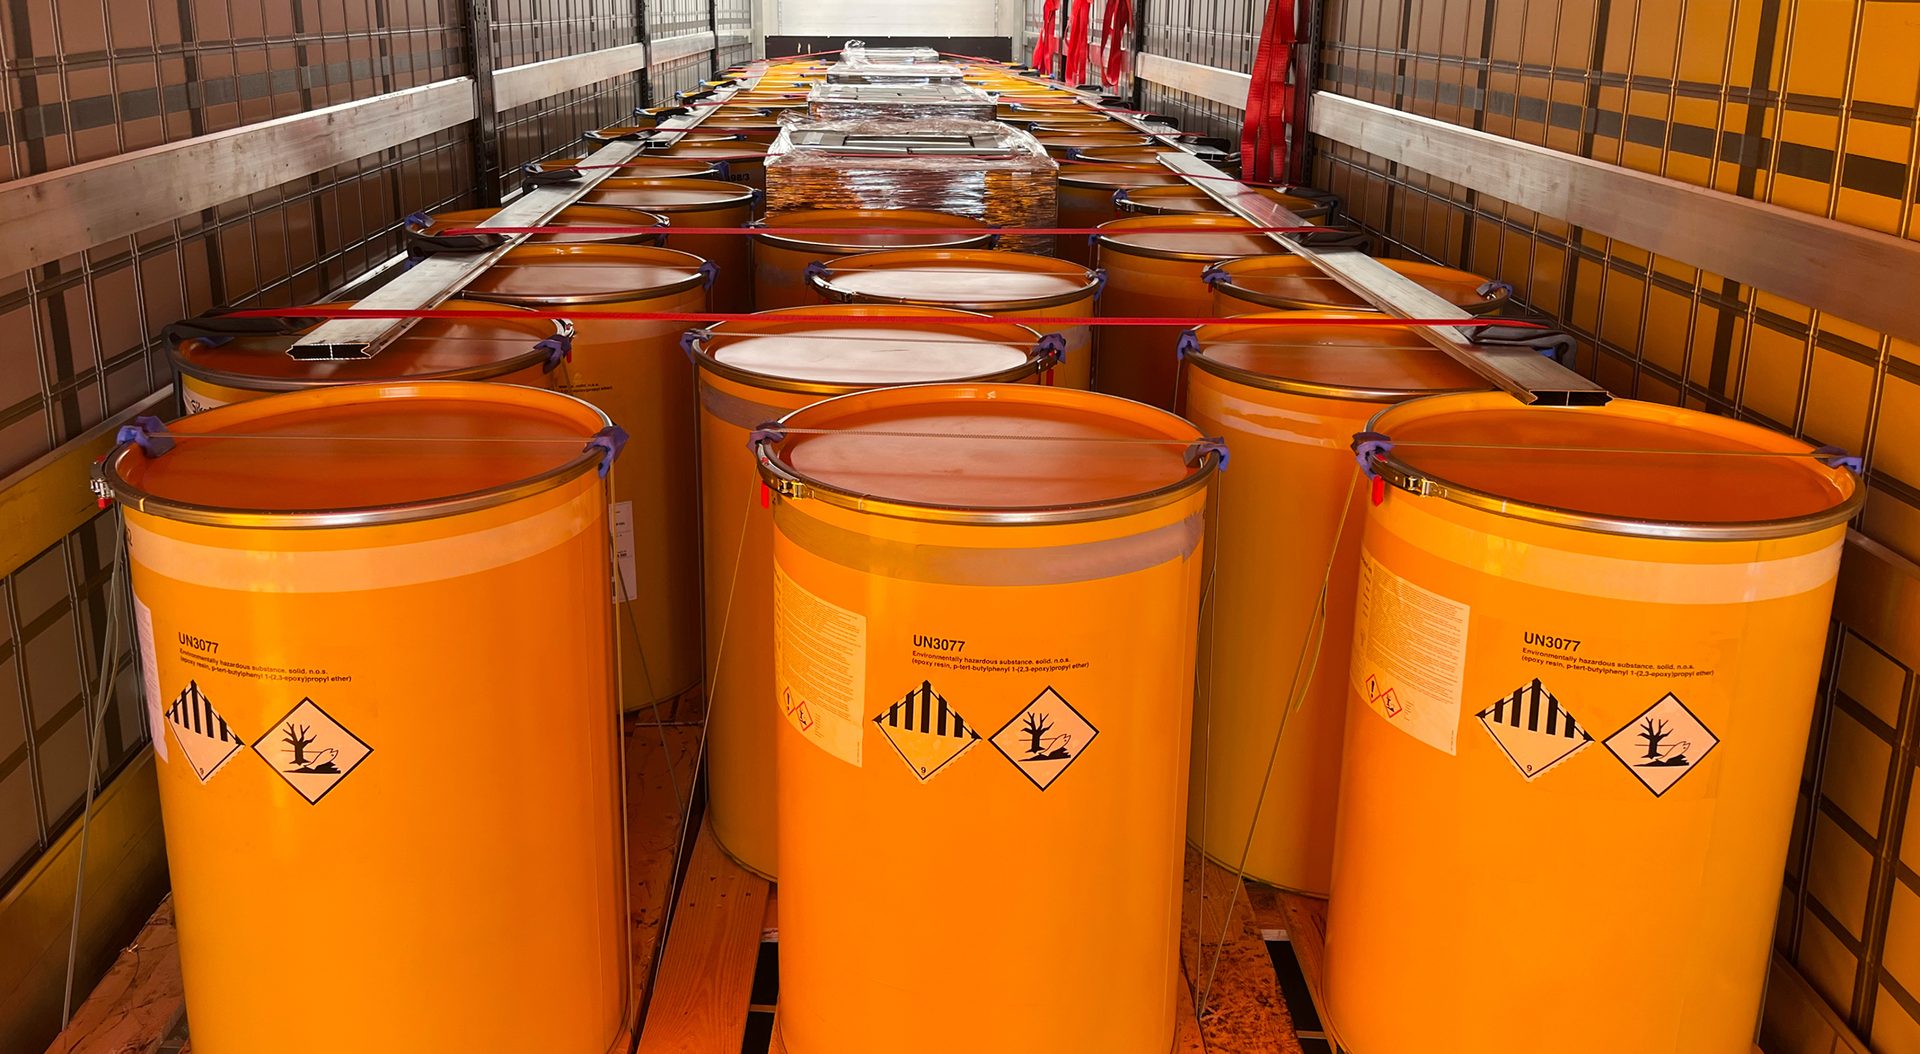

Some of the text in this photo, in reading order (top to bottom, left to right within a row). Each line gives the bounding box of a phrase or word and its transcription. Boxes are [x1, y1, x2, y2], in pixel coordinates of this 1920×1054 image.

[178, 631, 219, 654] UN3077
[913, 634, 966, 652] UN3077
[1524, 631, 1581, 652] UN3077
[219, 659, 251, 670] hazardous
[911, 657, 933, 667] (epoxy
[934, 661, 952, 669] resin,
[1071, 661, 1090, 670] ether)
[912, 650, 963, 664] Environmentally
[964, 656, 999, 666] hazardous
[1521, 654, 1544, 666] (epoxy
[1545, 659, 1565, 669] resin,
[1522, 647, 1578, 664] Environmentally
[1578, 656, 1616, 667] hazardous
[920, 766, 927, 775] 9
[1526, 764, 1533, 772] 9
